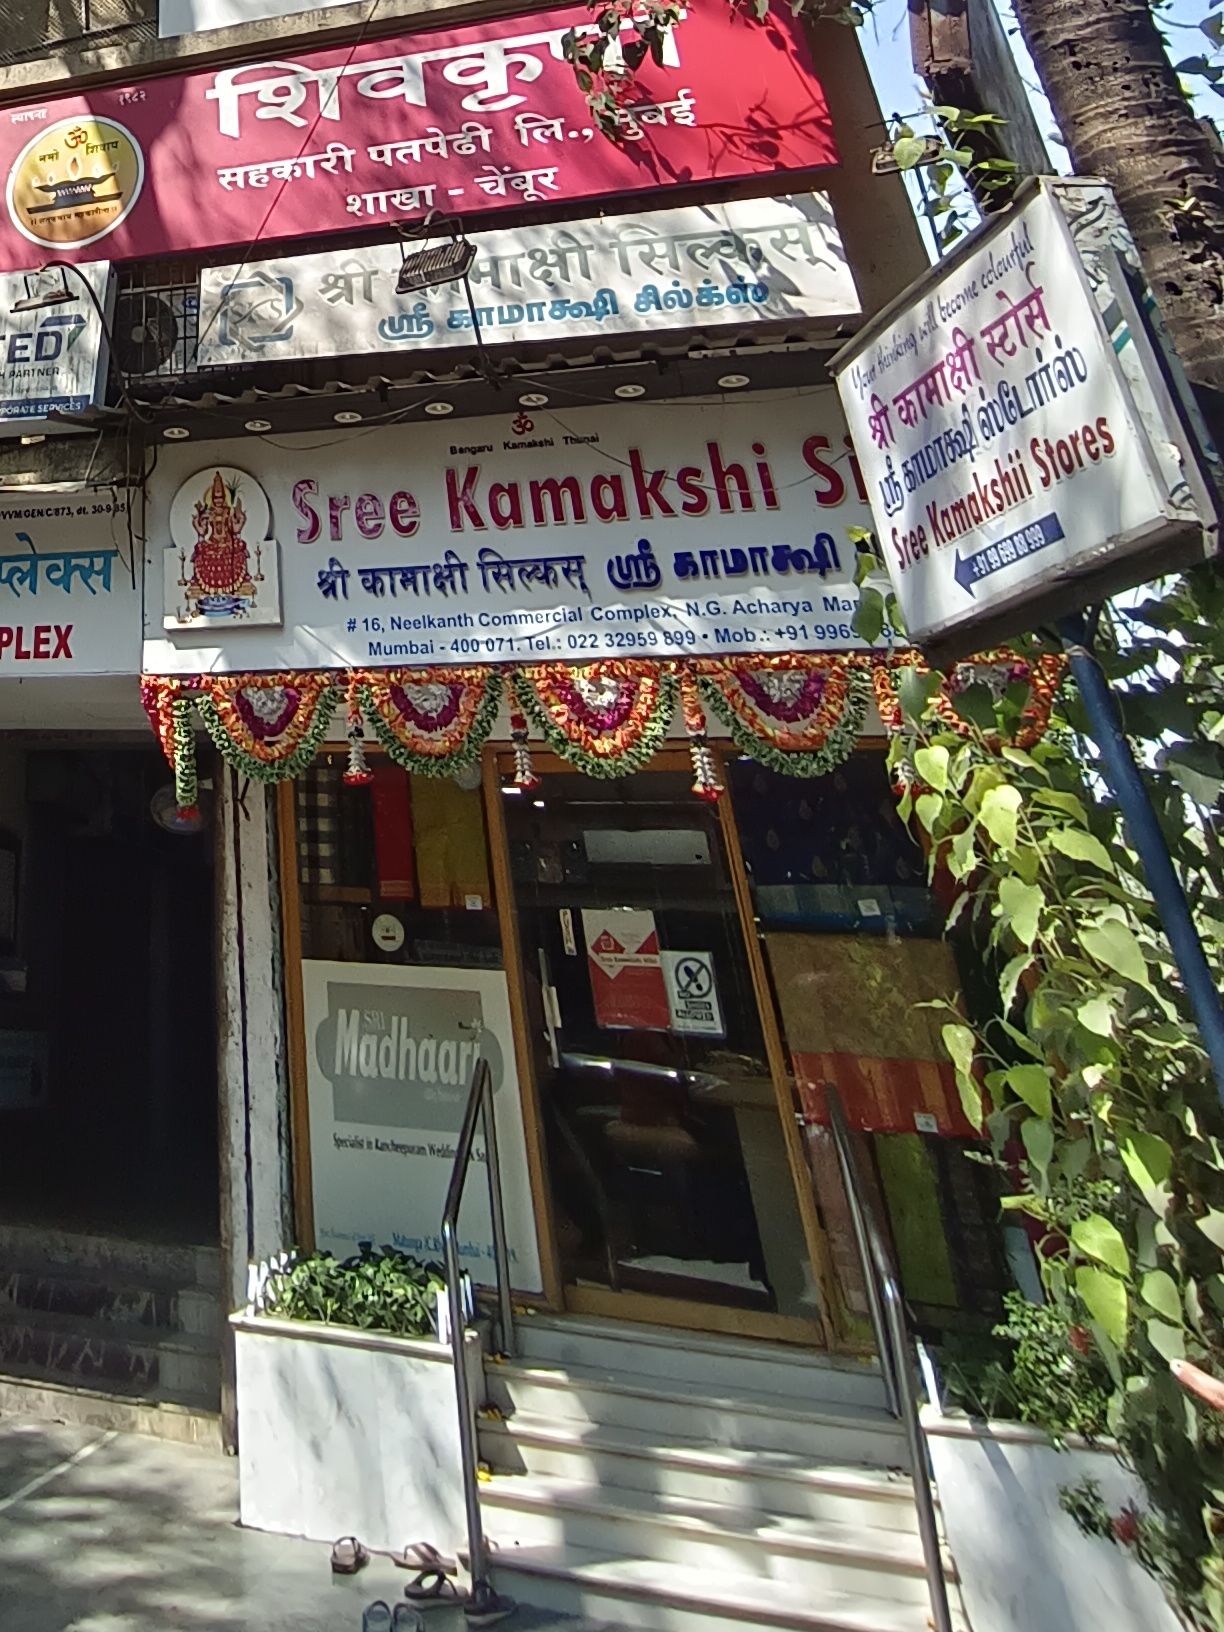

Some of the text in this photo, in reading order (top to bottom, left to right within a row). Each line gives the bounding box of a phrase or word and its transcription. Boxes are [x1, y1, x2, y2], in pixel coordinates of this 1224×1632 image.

[217, 143, 356, 191] सहकारी
[368, 123, 494, 169] पतपेढी
[346, 165, 561, 218] शाखा चेंबूर
[317, 258, 380, 306] श्री
[937, 279, 980, 323] become
[980, 221, 1035, 290] colourful
[8, 367, 60, 380] PARTNER
[868, 261, 1052, 450] श्री कामाक्षी स्टोर्स
[502, 436, 555, 451] Kamakshi
[291, 478, 421, 544] Sree
[444, 440, 780, 533] Kamakshi
[891, 416, 1117, 571] Sree Kamakshii Stores
[317, 555, 350, 601] श्री
[357, 549, 470, 598] कामाक्षी
[346, 595, 860, 635] # 16, Neelkanth Commercial Complex, N.G. Acharya Mar
[368, 641, 435, 657] Mumbai
[450, 638, 480, 653] 400
[485, 637, 522, 653] 071.
[567, 634, 599, 649] 022
[604, 631, 659, 648] 32959
[663, 629, 697, 646] 899
[774, 624, 809, 641] +91
